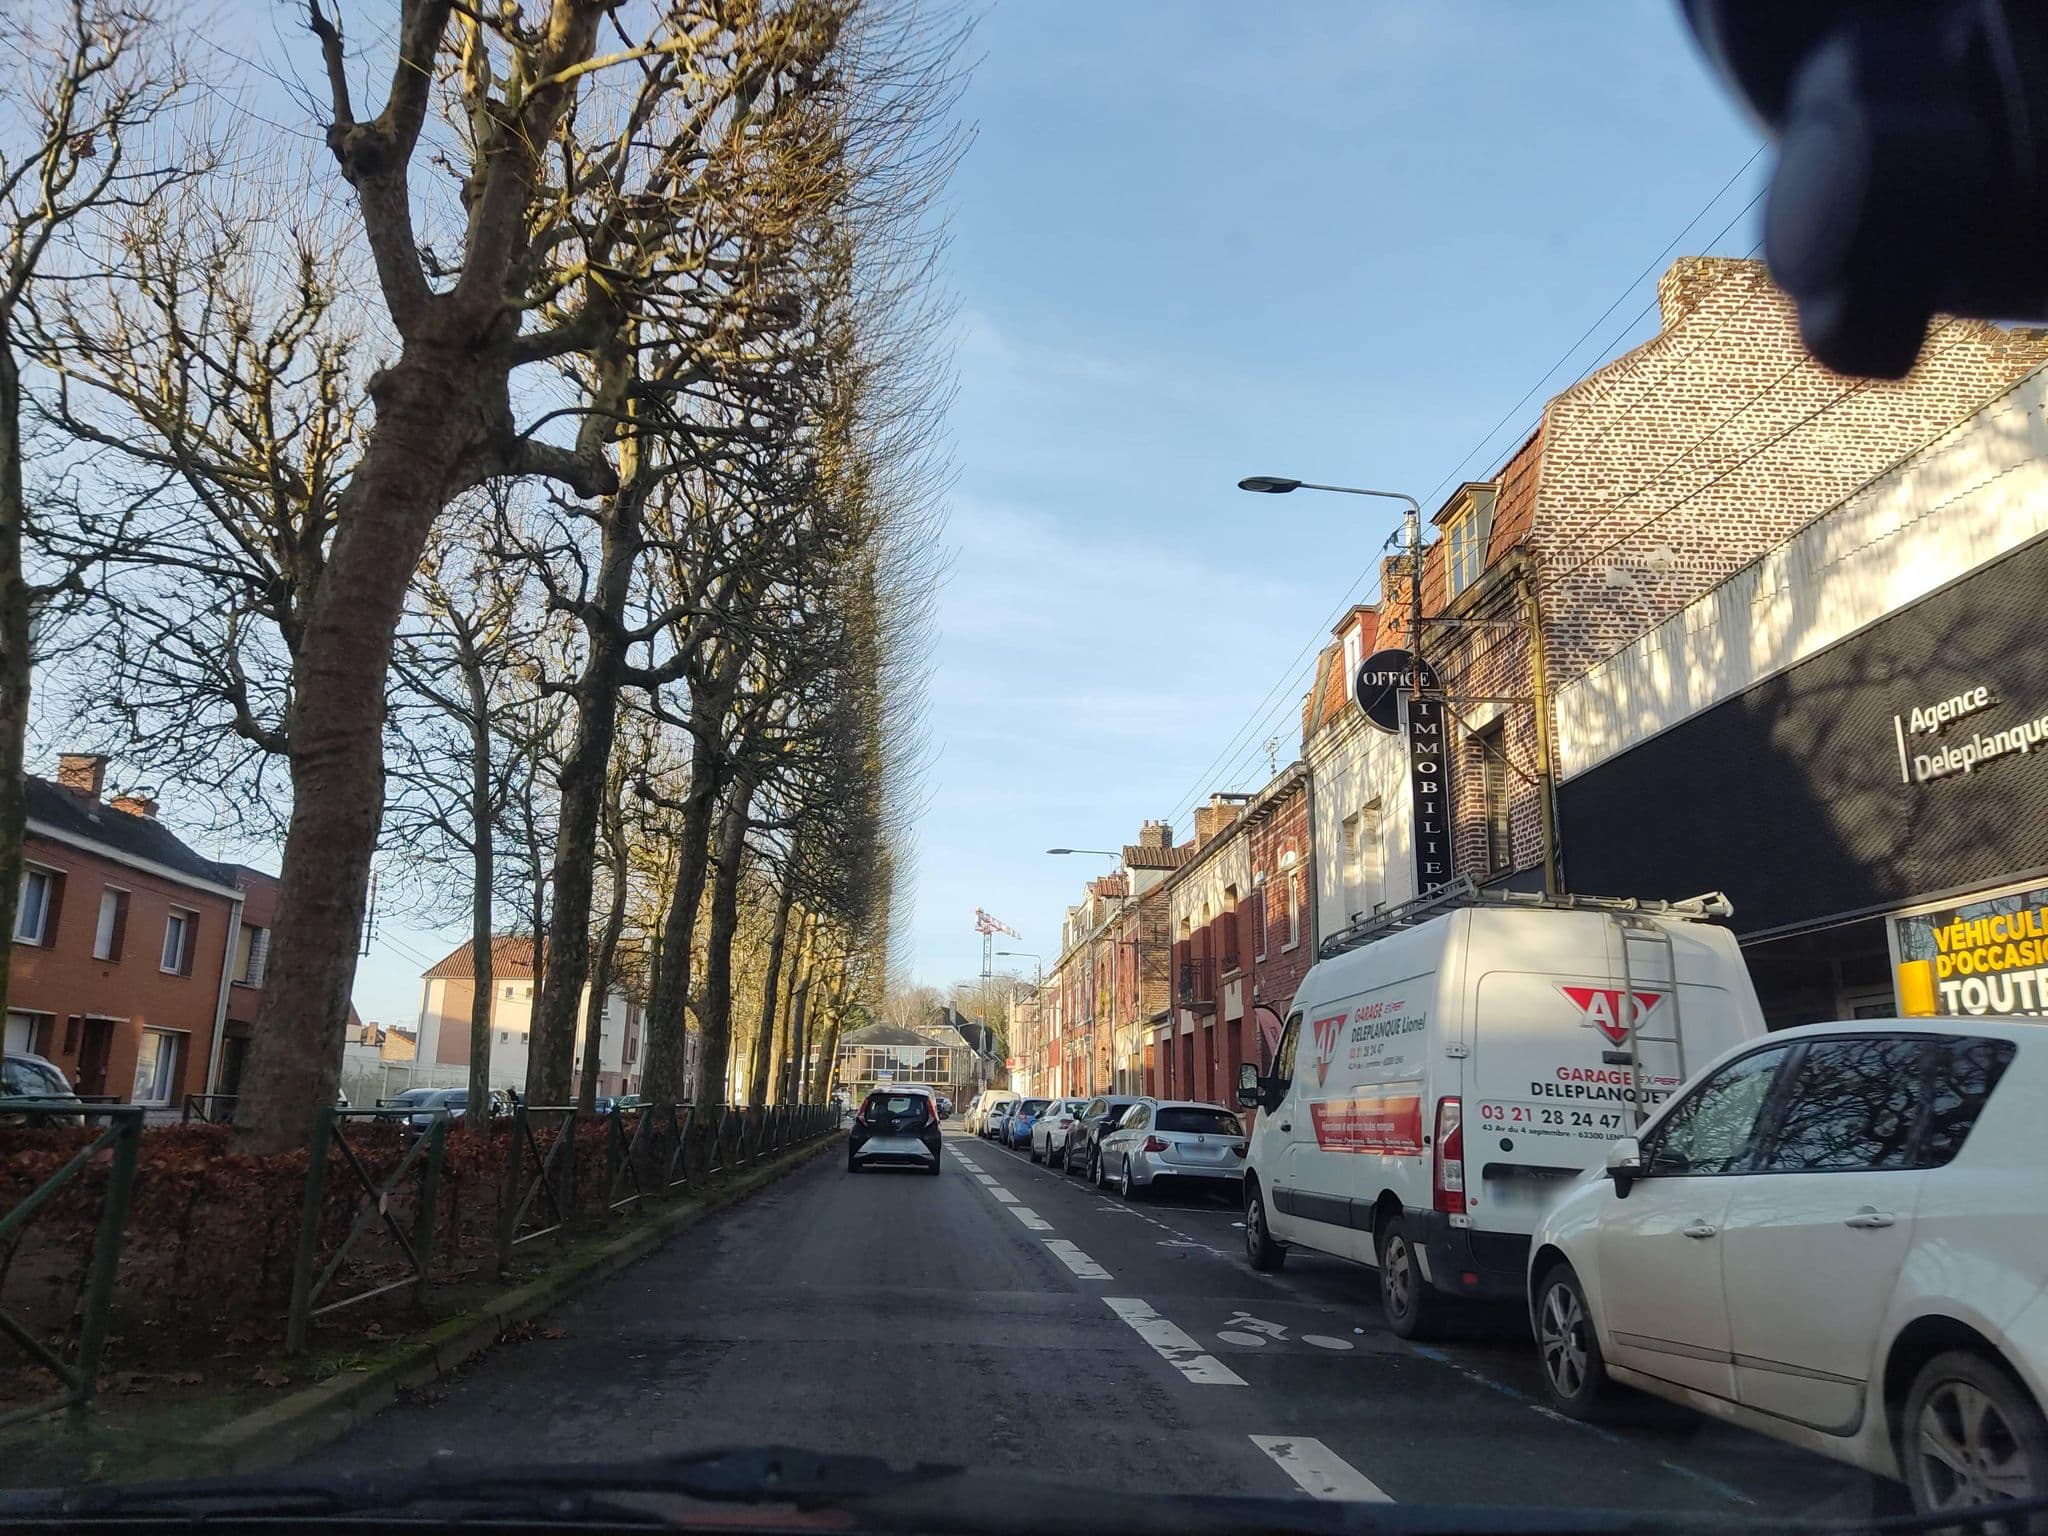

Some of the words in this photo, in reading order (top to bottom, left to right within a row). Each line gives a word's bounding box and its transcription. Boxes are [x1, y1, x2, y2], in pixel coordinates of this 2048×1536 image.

[1363, 671, 1431, 687] OFFICE
[1909, 686, 1989, 733] Agence
[1414, 703, 1445, 898] IMMOBILIER
[1355, 1003, 1383, 1023] GARAGE
[1352, 1019, 1401, 1042] DELEPLANQUE
[1402, 1012, 1426, 1034] Lionel
[1556, 1067, 1632, 1085] GARAGE
[1531, 1082, 1662, 1104] DELEPLANQUE
[1481, 1105, 1505, 1121] 03
[1511, 1107, 1532, 1122] 21
[1541, 1109, 1564, 1125] 28
[1571, 1112, 1593, 1127] 24
[1600, 1114, 1622, 1129] 47
[1529, 1128, 1571, 1137] septembre
